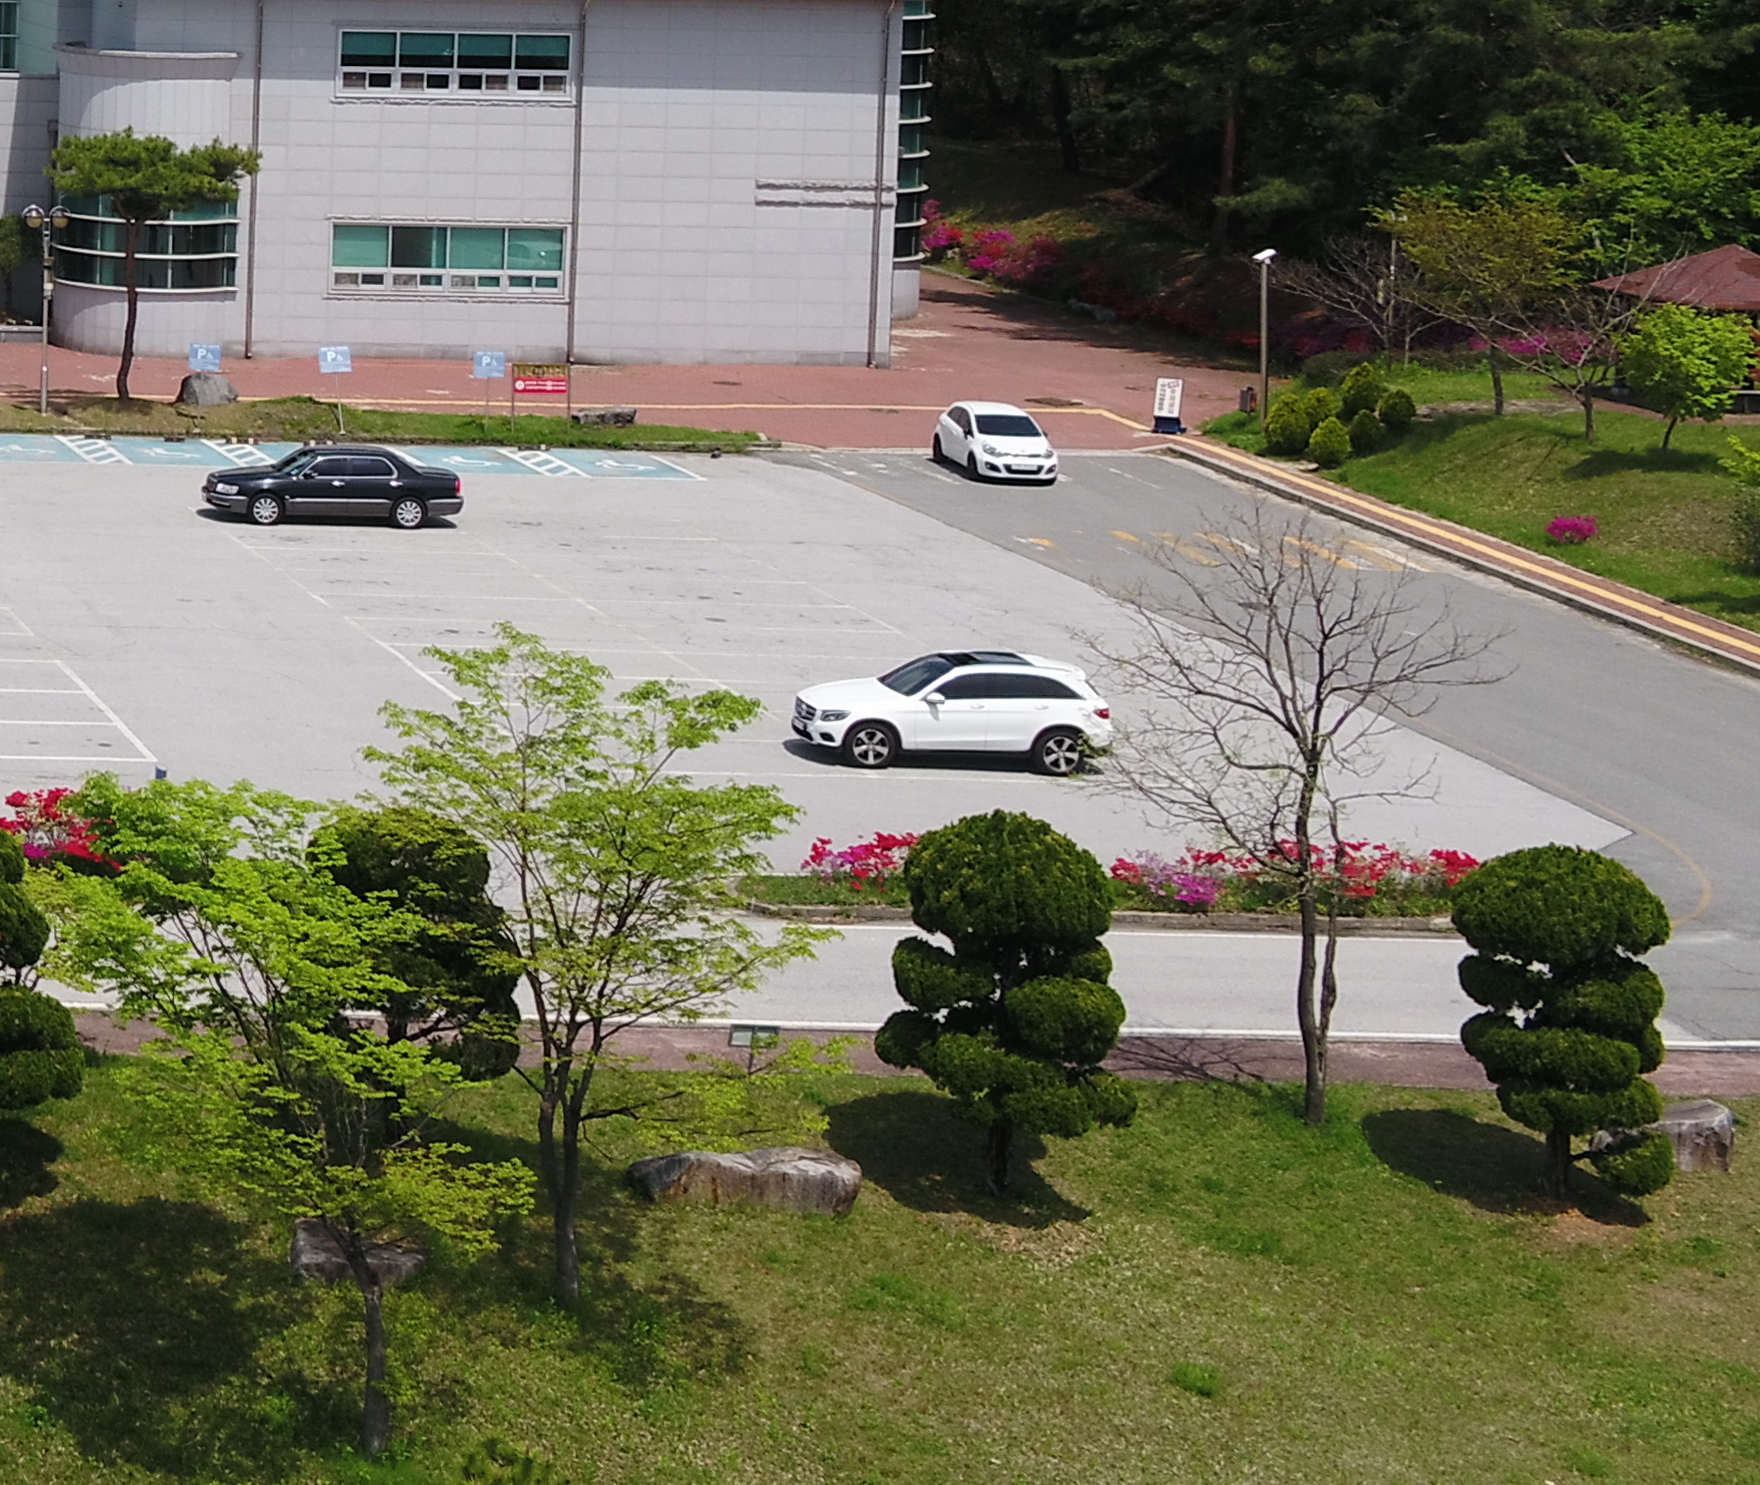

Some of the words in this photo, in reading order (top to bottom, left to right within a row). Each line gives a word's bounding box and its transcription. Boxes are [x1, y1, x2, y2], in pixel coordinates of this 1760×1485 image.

[197, 348, 207, 360] P
[326, 351, 336, 362] P
[481, 355, 491, 367] P
